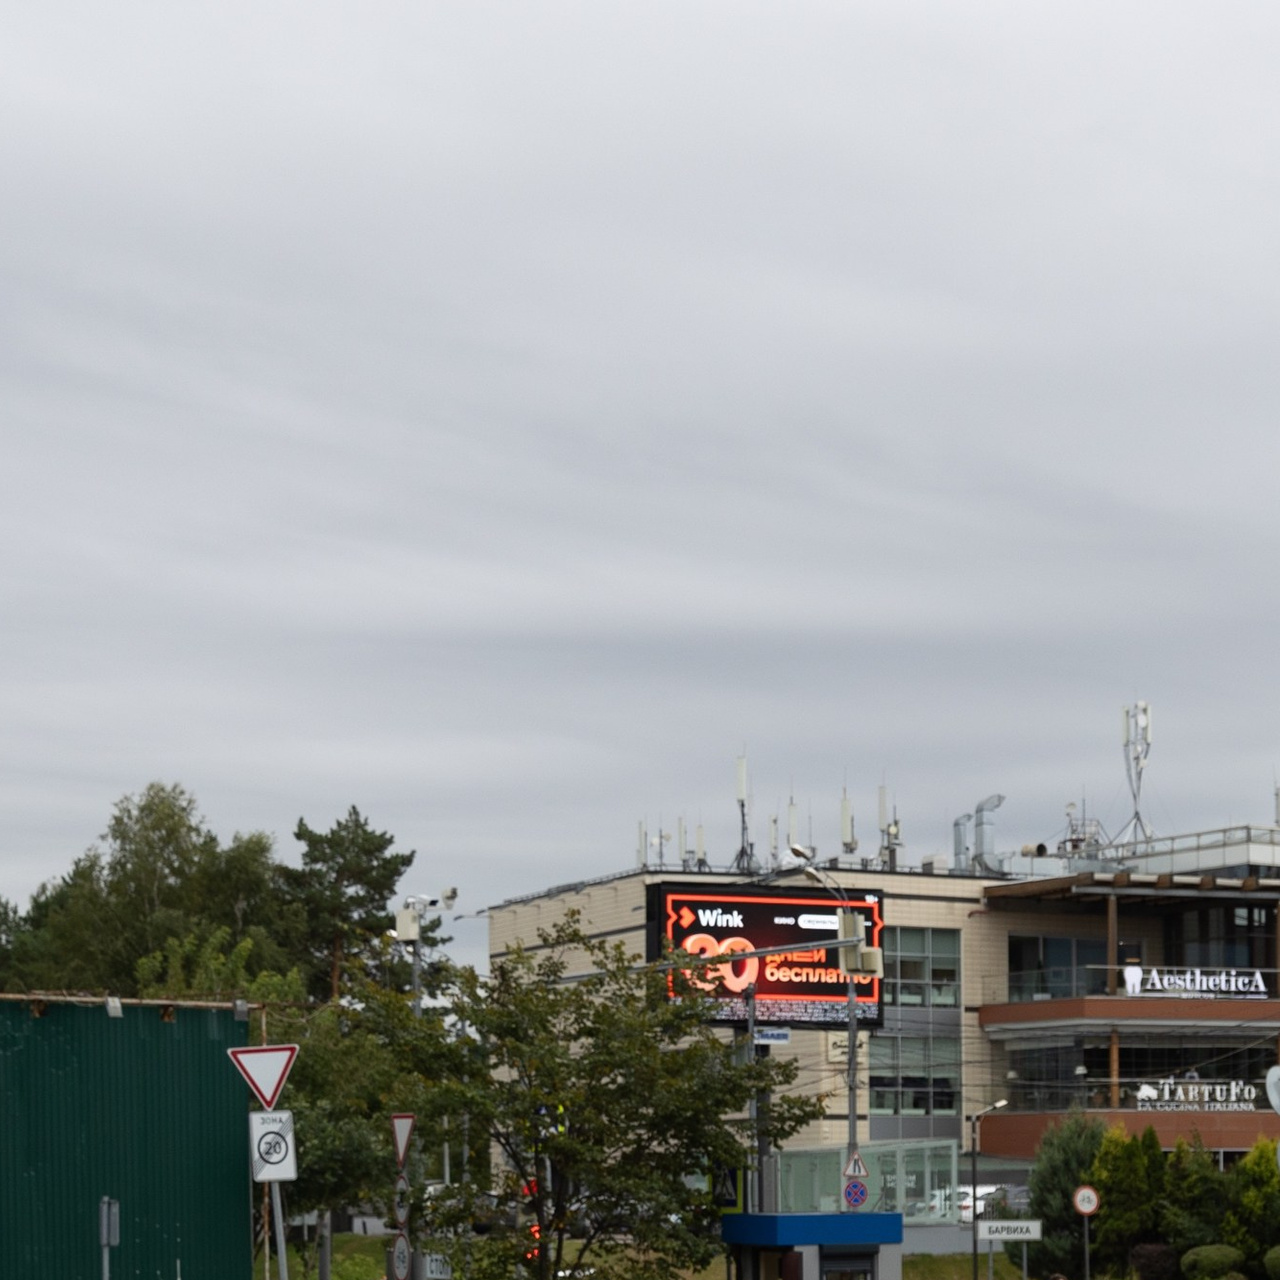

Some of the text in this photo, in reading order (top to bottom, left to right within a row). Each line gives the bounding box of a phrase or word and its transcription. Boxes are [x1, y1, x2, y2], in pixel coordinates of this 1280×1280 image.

[698, 908, 744, 929] Wink
[1145, 967, 1268, 992] AestheticA
[1155, 1102, 1200, 1111] CUCINA
[1204, 1102, 1256, 1112] ITALIANA
[260, 1116, 284, 1125] ЗОНА
[264, 1141, 282, 1156] 20
[987, 1224, 1032, 1236] БАРВИХА
